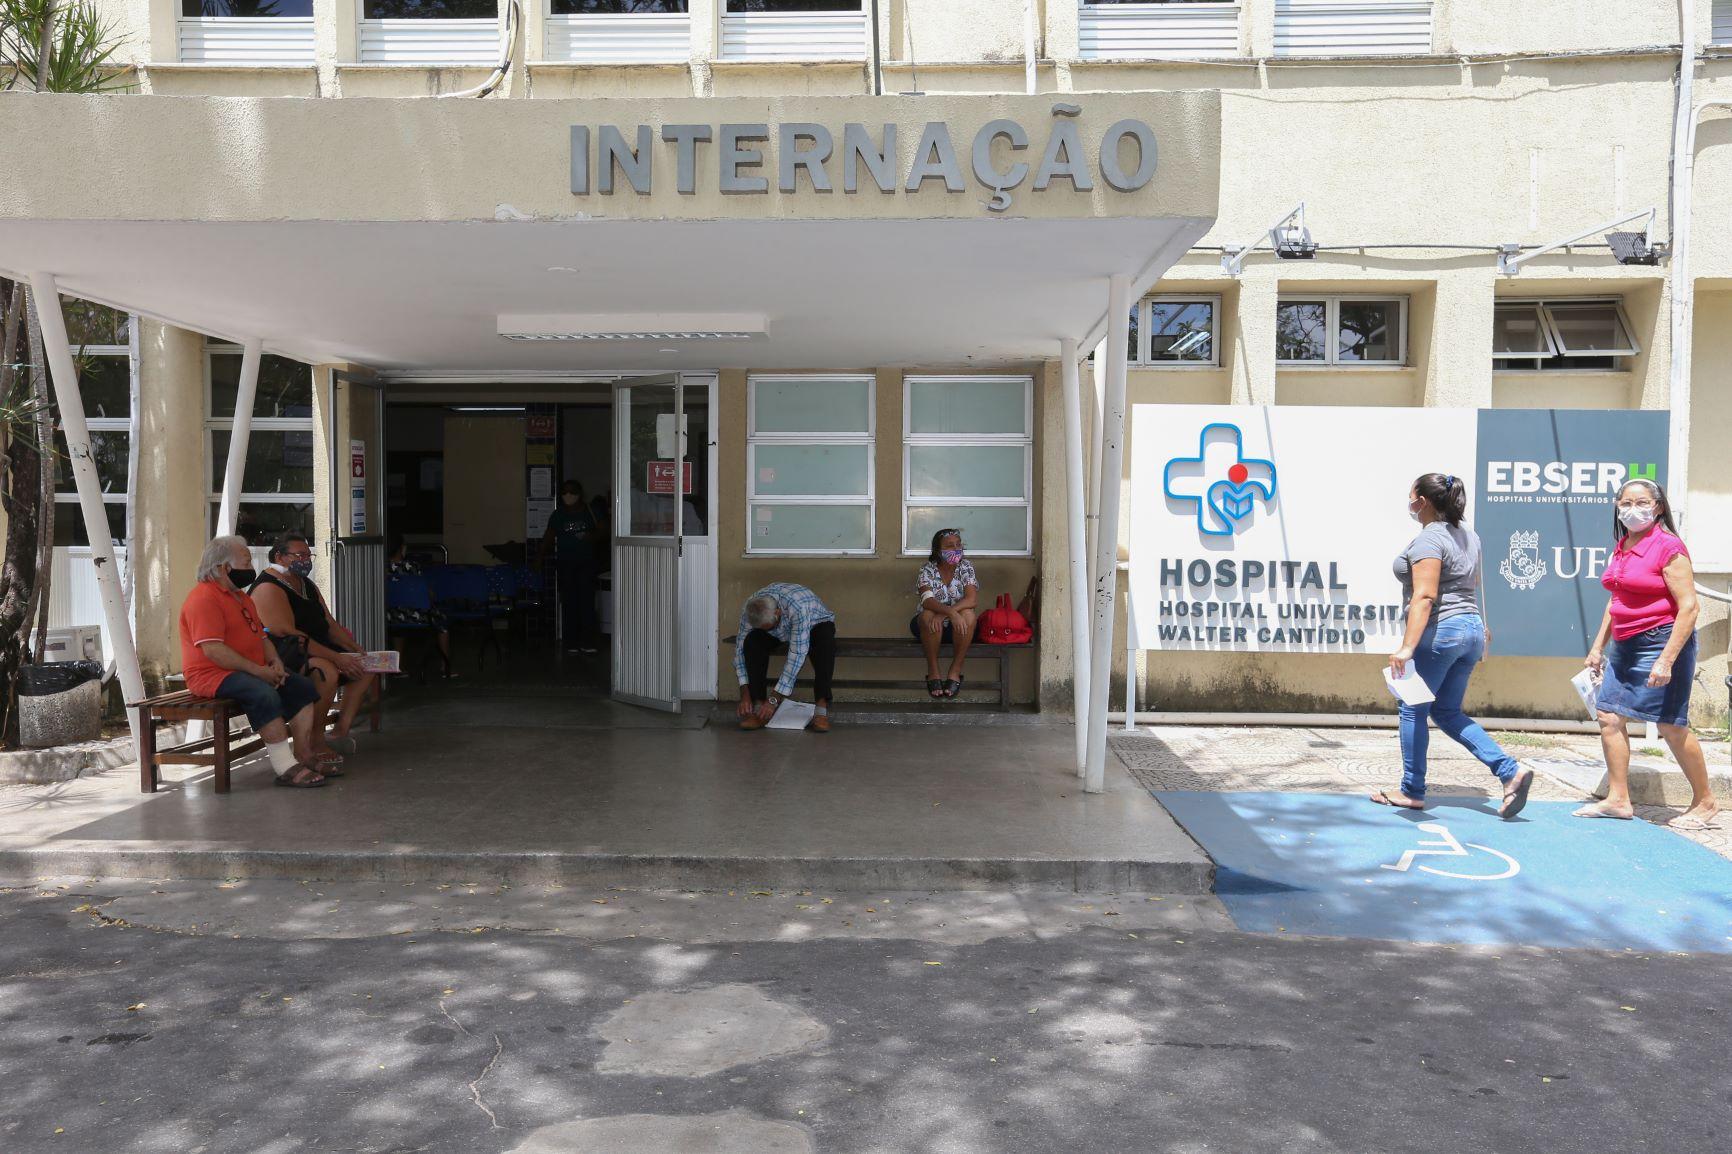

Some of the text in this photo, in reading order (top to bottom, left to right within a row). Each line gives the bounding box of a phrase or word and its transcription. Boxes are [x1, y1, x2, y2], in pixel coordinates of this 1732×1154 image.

[570, 103, 1158, 211] INTERNAÇÃO
[1487, 495, 1533, 503] HOSPITAIS
[1536, 495, 1609, 504] UNIVERSITÁRIOS
[1160, 558, 1348, 590] HOSPITAL
[1552, 546, 1613, 579] UF
[1159, 601, 1268, 619] HOSPITAL
[1158, 624, 1366, 645] WALTER CANTÍDIO
